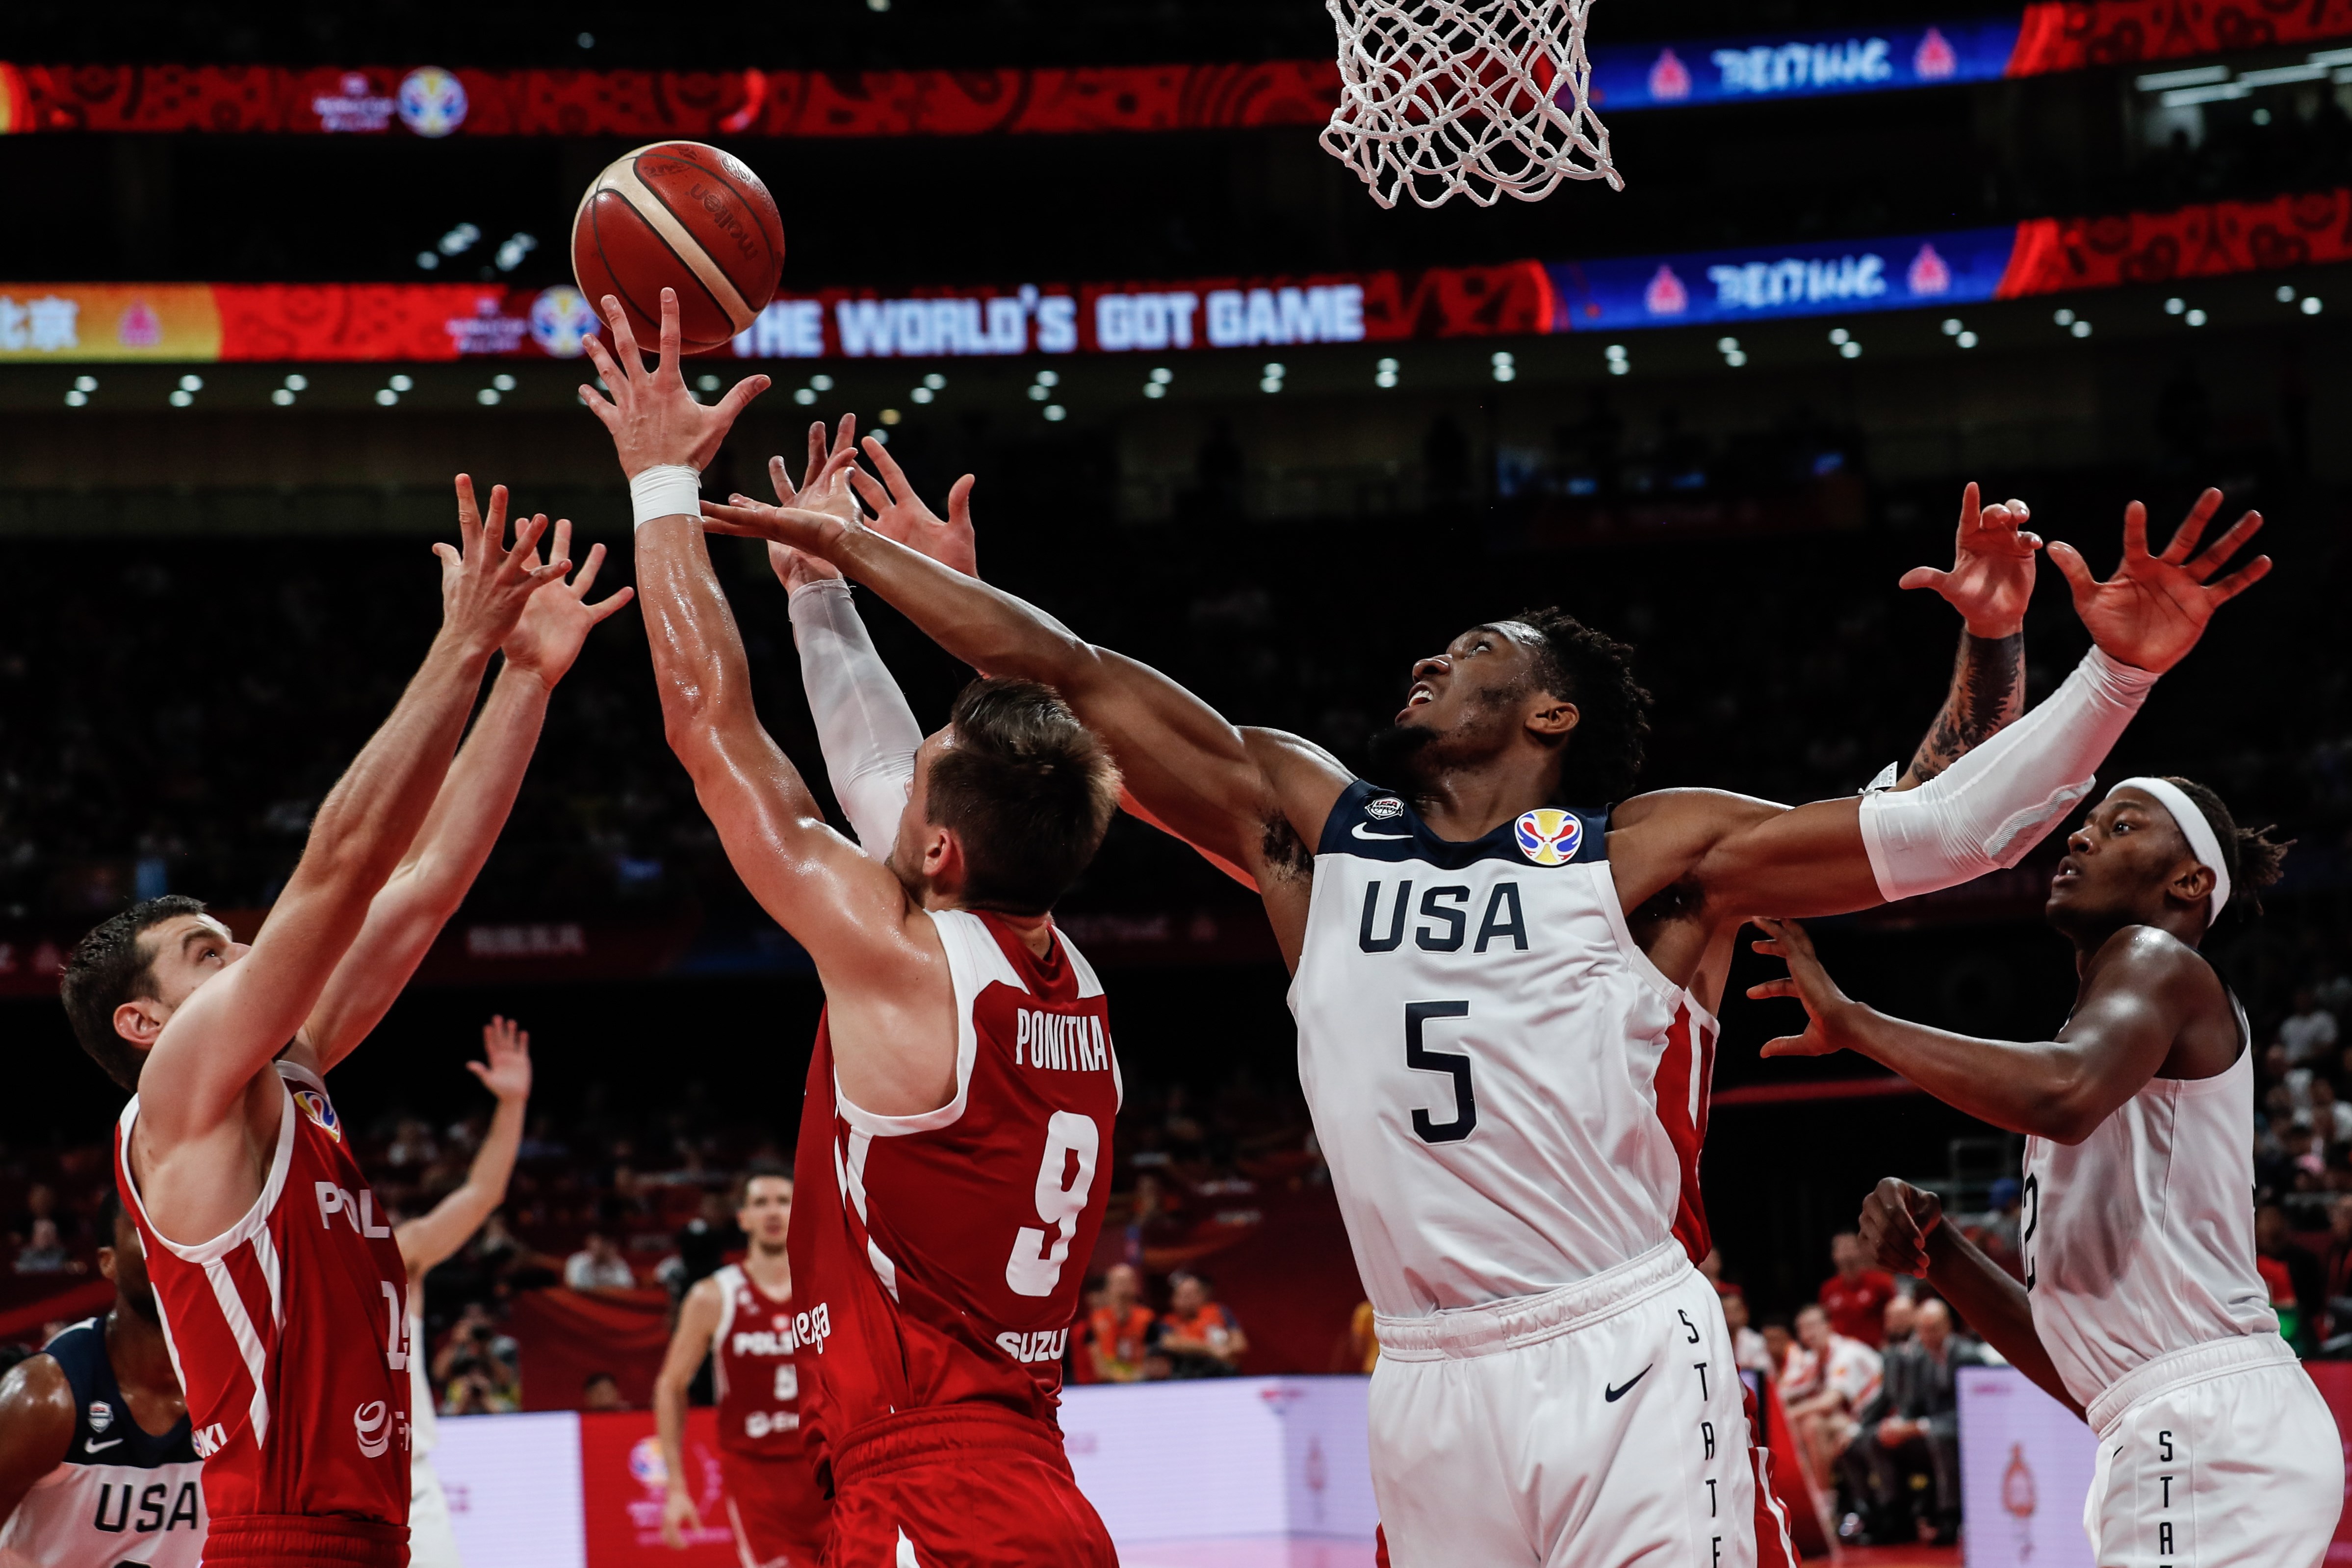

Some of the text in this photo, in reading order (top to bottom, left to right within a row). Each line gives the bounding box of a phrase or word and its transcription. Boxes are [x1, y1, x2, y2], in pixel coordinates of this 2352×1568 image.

[690, 183, 758, 261] molten
[835, 283, 1078, 356] WORLD'S
[1096, 292, 1199, 351] GOT
[1206, 283, 1365, 346] GAME
[1359, 880, 1530, 955] USA
[1016, 1008, 1109, 1072] PONITKA
[1405, 1000, 1478, 1146] 5
[1006, 1110, 1099, 1296] 9
[996, 1327, 1068, 1363] SUZU
[194, 1422, 228, 1459] KI
[94, 1482, 198, 1533] USA
[2159, 1431, 2173, 1568] STA
